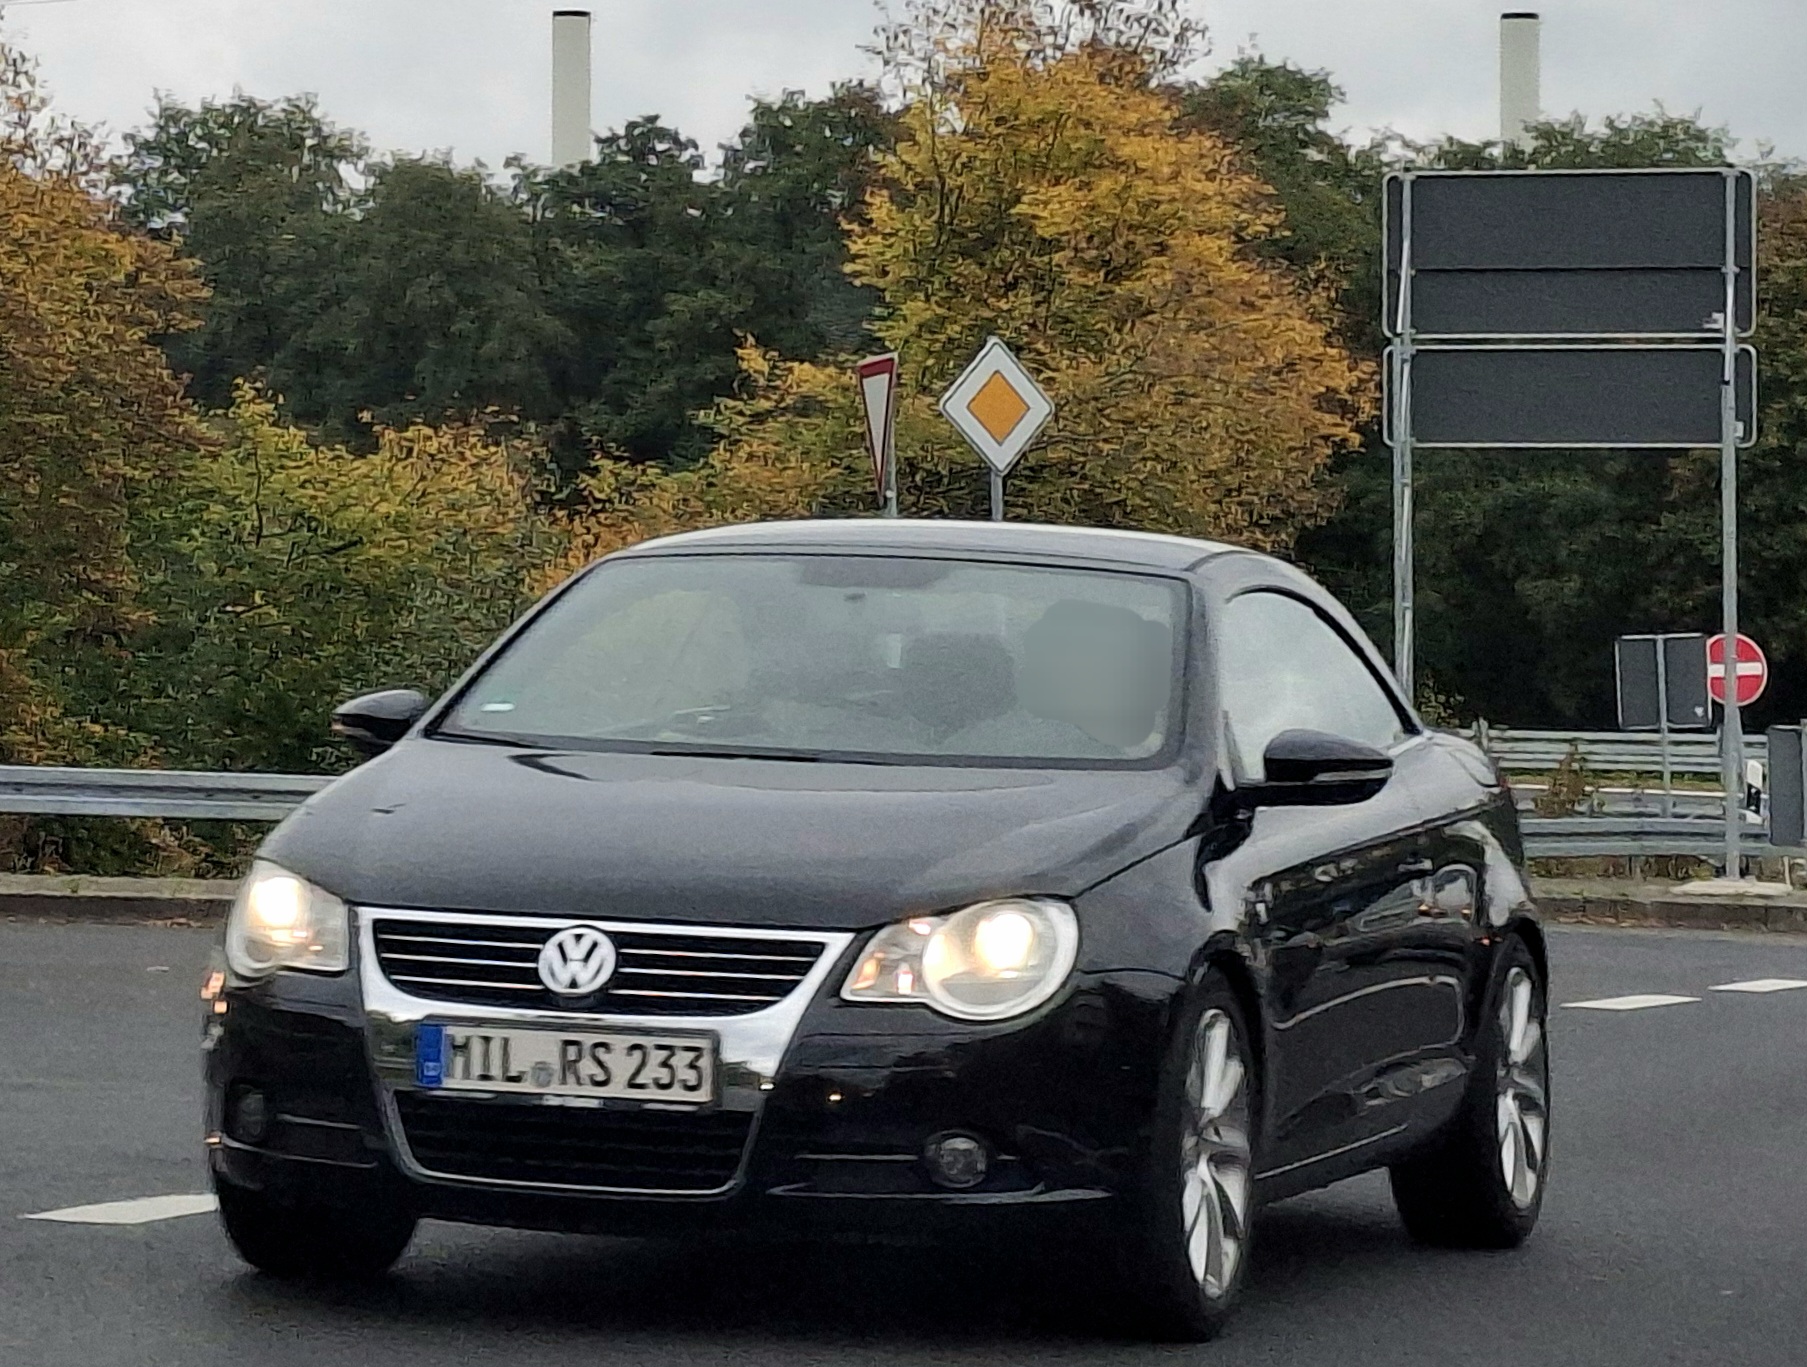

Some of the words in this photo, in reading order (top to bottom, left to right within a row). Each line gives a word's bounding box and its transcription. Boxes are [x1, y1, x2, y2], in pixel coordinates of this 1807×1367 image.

[543, 931, 611, 991] VW
[446, 1034, 524, 1083] HIL
[560, 1039, 612, 1087] RS
[625, 1043, 704, 1092] 233
